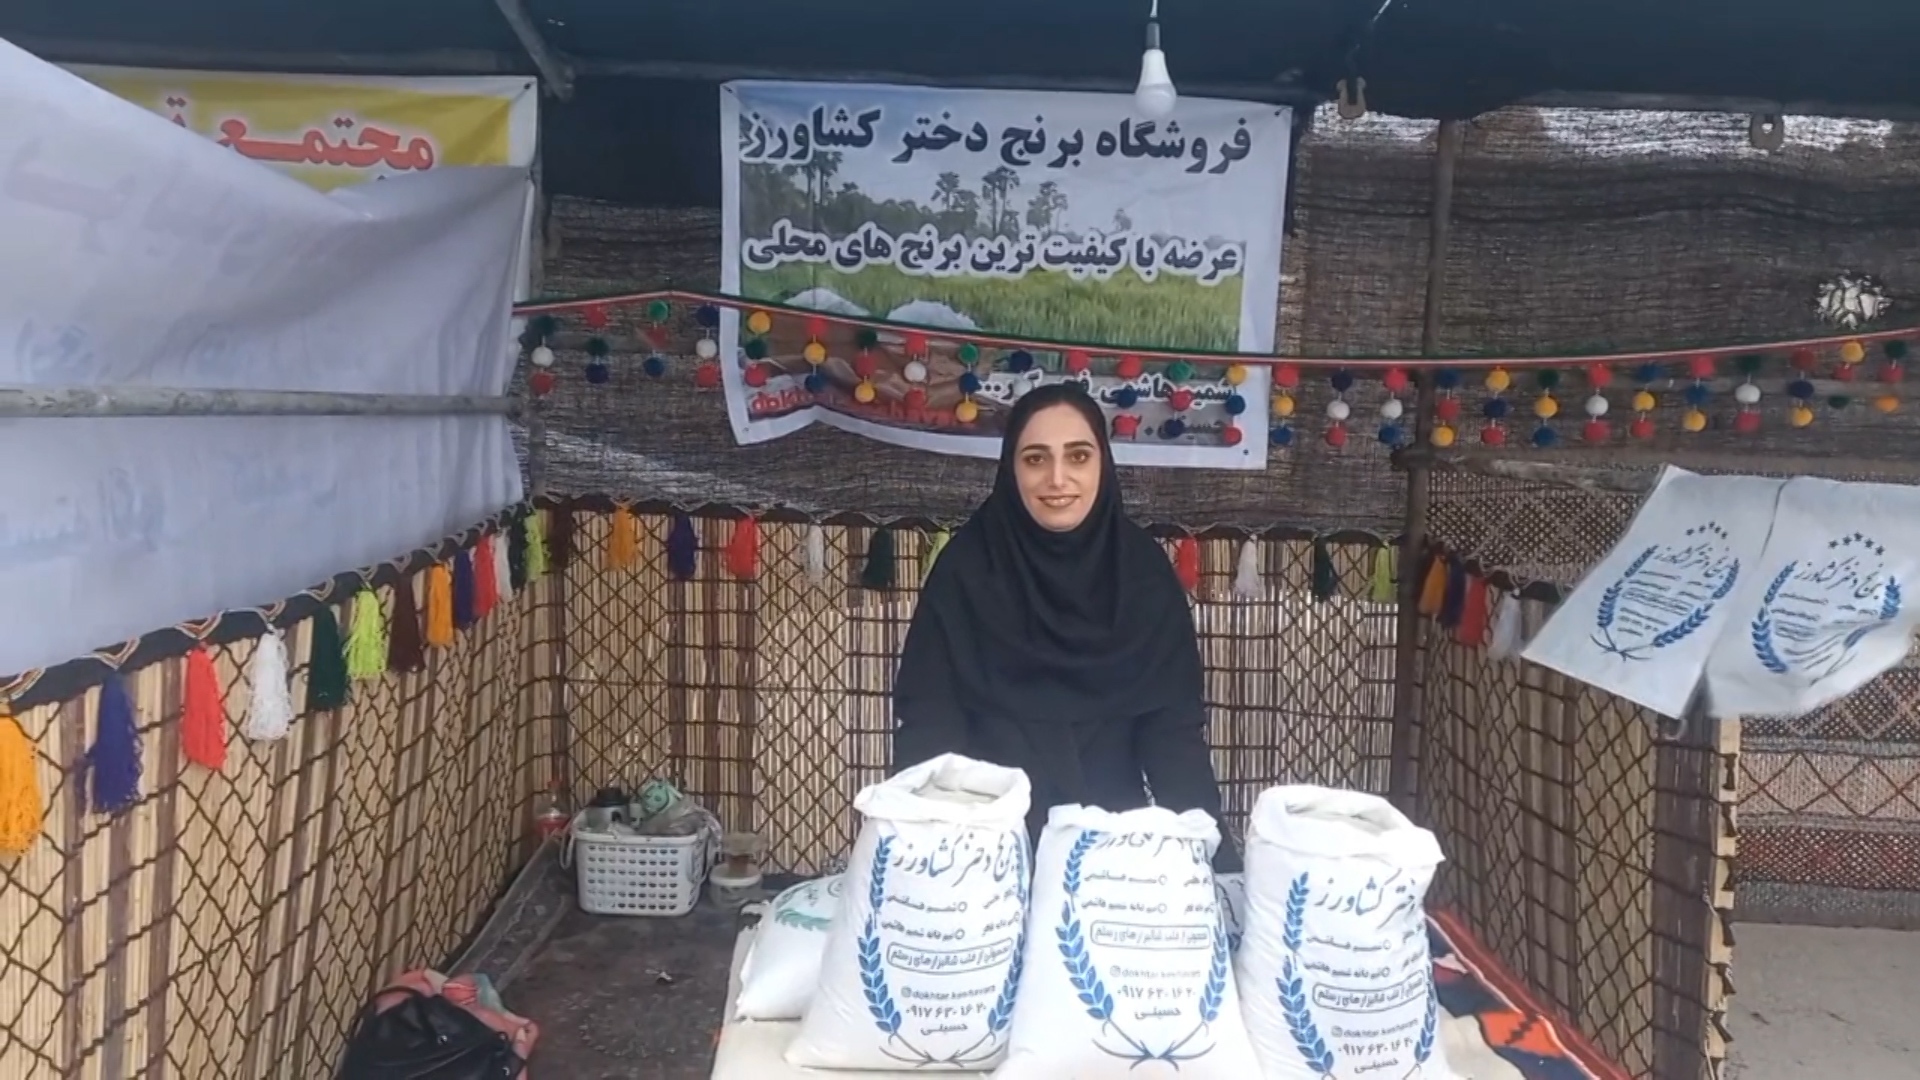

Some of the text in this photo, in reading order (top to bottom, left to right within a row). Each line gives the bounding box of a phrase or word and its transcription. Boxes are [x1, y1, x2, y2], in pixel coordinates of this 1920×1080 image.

[741, 105, 1251, 174] فروشگاه برنج دختر کشاورز
[748, 226, 1238, 280] عرضه با کیفیت ترین برنج های محلی
